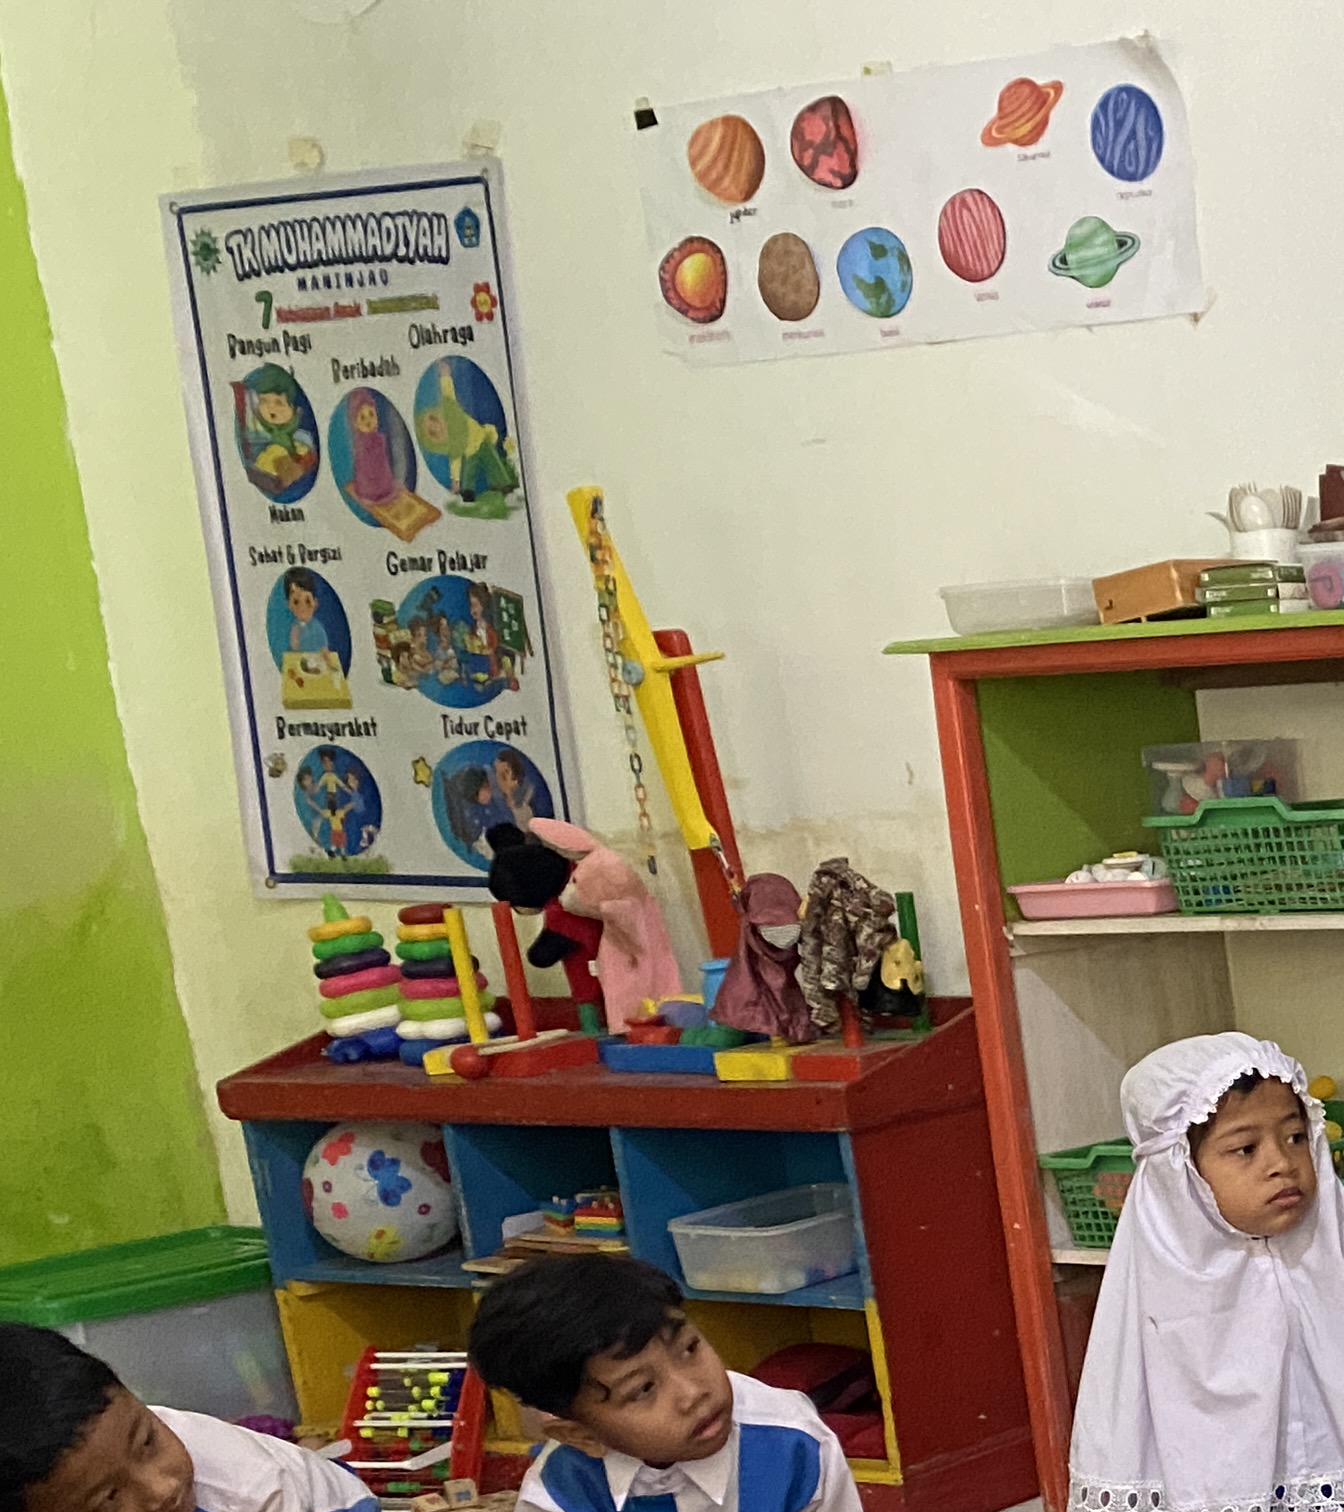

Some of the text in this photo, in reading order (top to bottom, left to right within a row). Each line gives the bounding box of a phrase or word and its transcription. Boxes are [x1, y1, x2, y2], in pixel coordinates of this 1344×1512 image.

[225, 209, 450, 281] TK MUHAMMADIYAH
[297, 268, 389, 291] MANINJAU
[255, 290, 273, 329] 7
[227, 329, 313, 360] Bangun Pagi
[408, 322, 475, 349] Olahraga
[386, 548, 489, 576] Gemar Belajar
[275, 716, 378, 740] Bermasyarakat
[441, 714, 528, 740] Tidur Cepat
